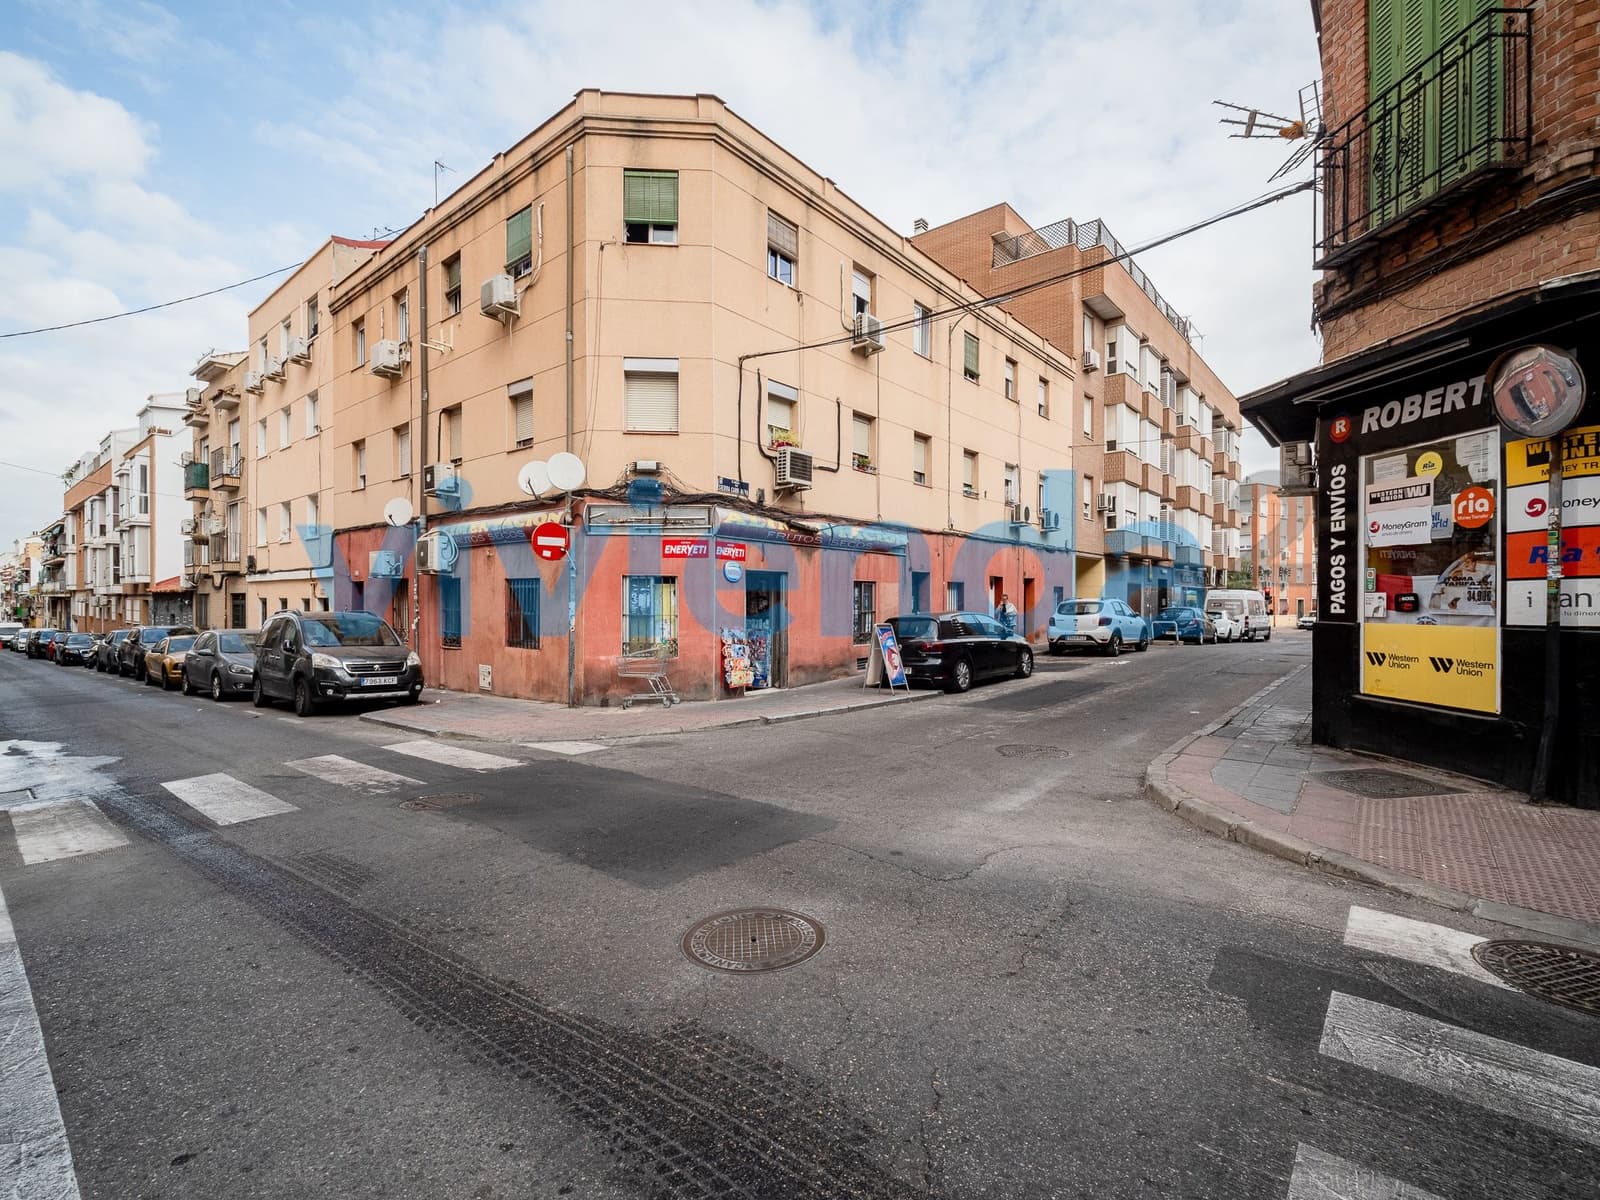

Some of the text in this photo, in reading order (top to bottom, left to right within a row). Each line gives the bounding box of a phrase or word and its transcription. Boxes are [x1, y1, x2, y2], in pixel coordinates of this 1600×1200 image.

[1336, 420, 1346, 435] R
[1371, 488, 1404, 499] WESTERN
[1380, 494, 1404, 502] UNION
[1458, 492, 1490, 514] ria
[1382, 516, 1427, 531] MoneyGram
[767, 530, 873, 550] FRUTOS SECOS
[1327, 463, 1347, 615] PAGOS Y ENVÍOS
[664, 544, 707, 556] ENERYETI
[716, 546, 745, 559] ENERYETI
[1388, 653, 1419, 664] Western
[1456, 659, 1494, 670] Western
[1388, 661, 1411, 670] Union
[1456, 667, 1483, 677] Union
